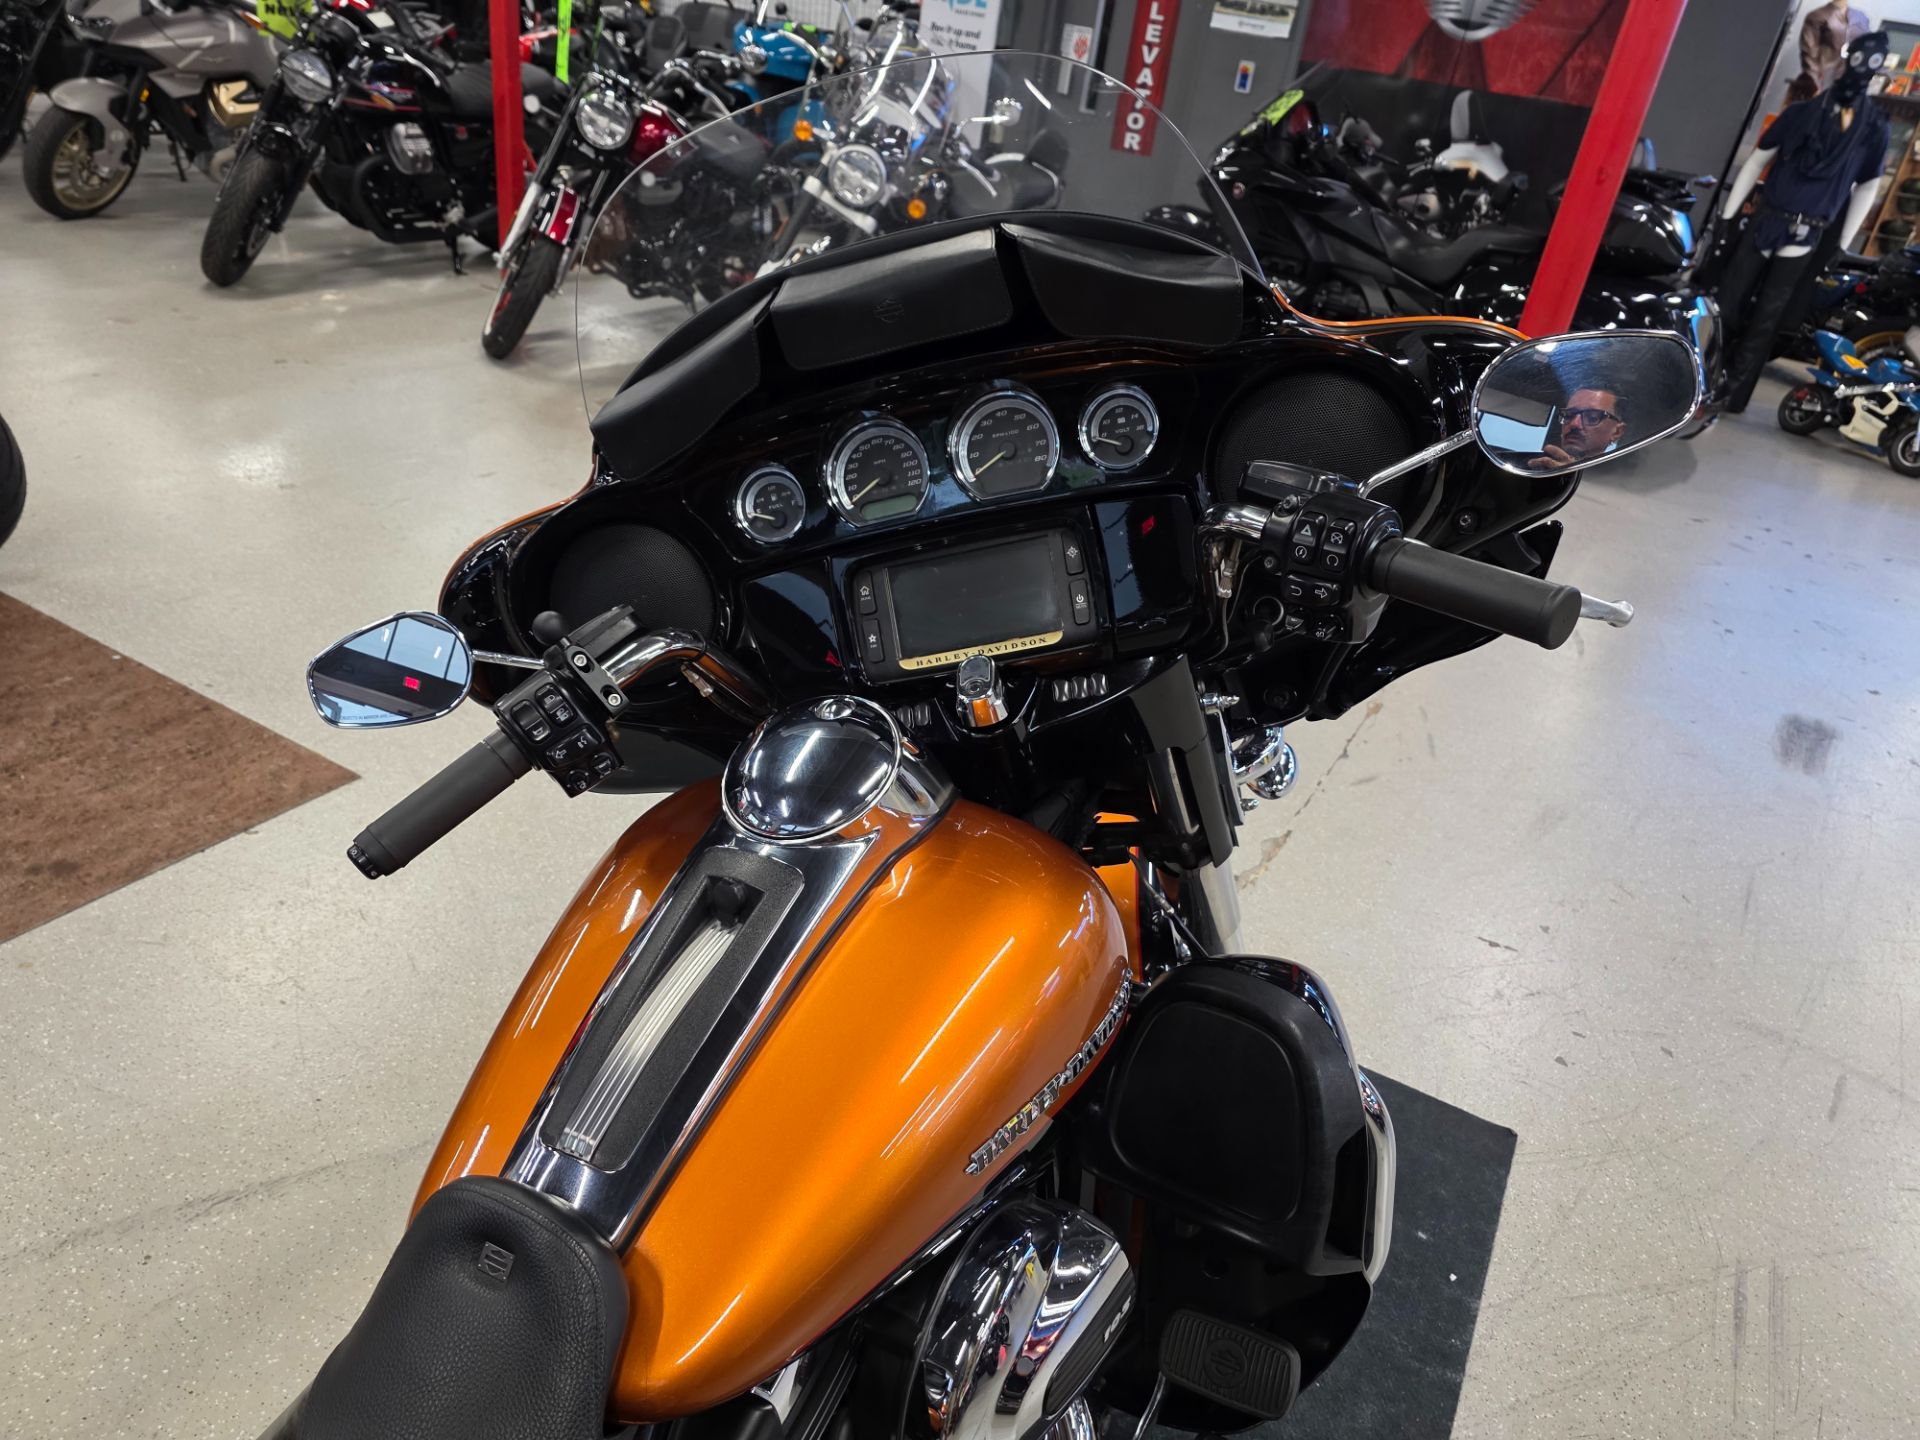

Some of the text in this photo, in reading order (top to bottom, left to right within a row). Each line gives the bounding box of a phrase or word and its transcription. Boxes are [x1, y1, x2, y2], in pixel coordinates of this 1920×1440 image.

[1026, 423, 1040, 431] 60
[971, 433, 984, 441] 20
[1035, 439, 1047, 447] 70
[901, 450, 913, 458] 90
[970, 451, 980, 459] 10
[1034, 454, 1048, 462] 80
[847, 462, 858, 470] 30
[903, 459, 918, 468] 100
[846, 472, 858, 480] 20
[907, 469, 921, 478] 110
[907, 478, 922, 487] 120
[848, 484, 857, 492] 10
[916, 637, 1047, 667] HARLEY-DAVIDSON
